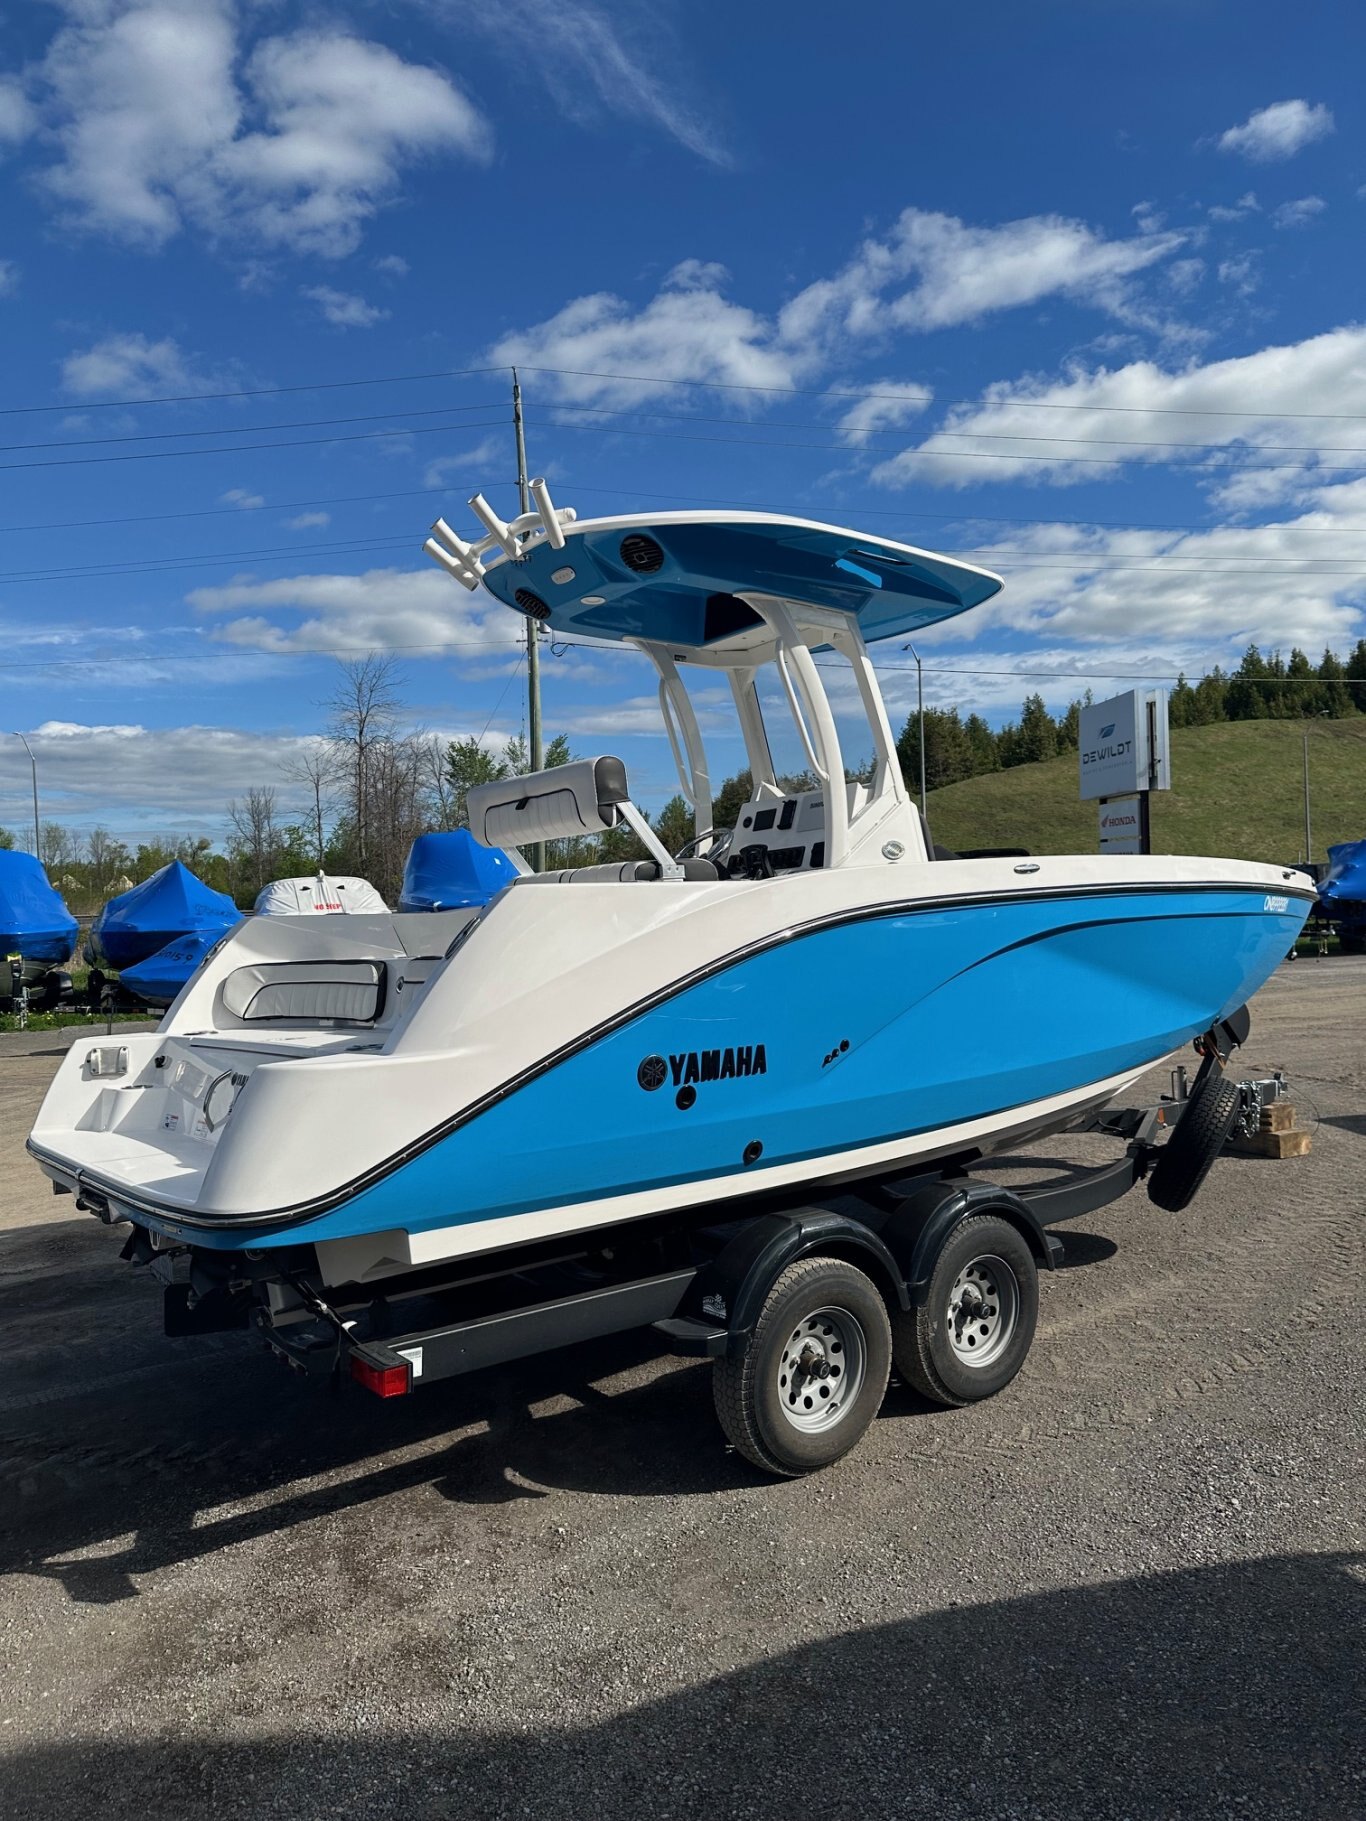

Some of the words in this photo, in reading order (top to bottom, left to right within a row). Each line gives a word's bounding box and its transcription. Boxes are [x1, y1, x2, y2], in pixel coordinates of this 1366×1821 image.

[1082, 740, 1132, 765] DEWILDT
[1108, 816, 1136, 827] HONDA
[669, 1044, 767, 1086] YAMAHA
